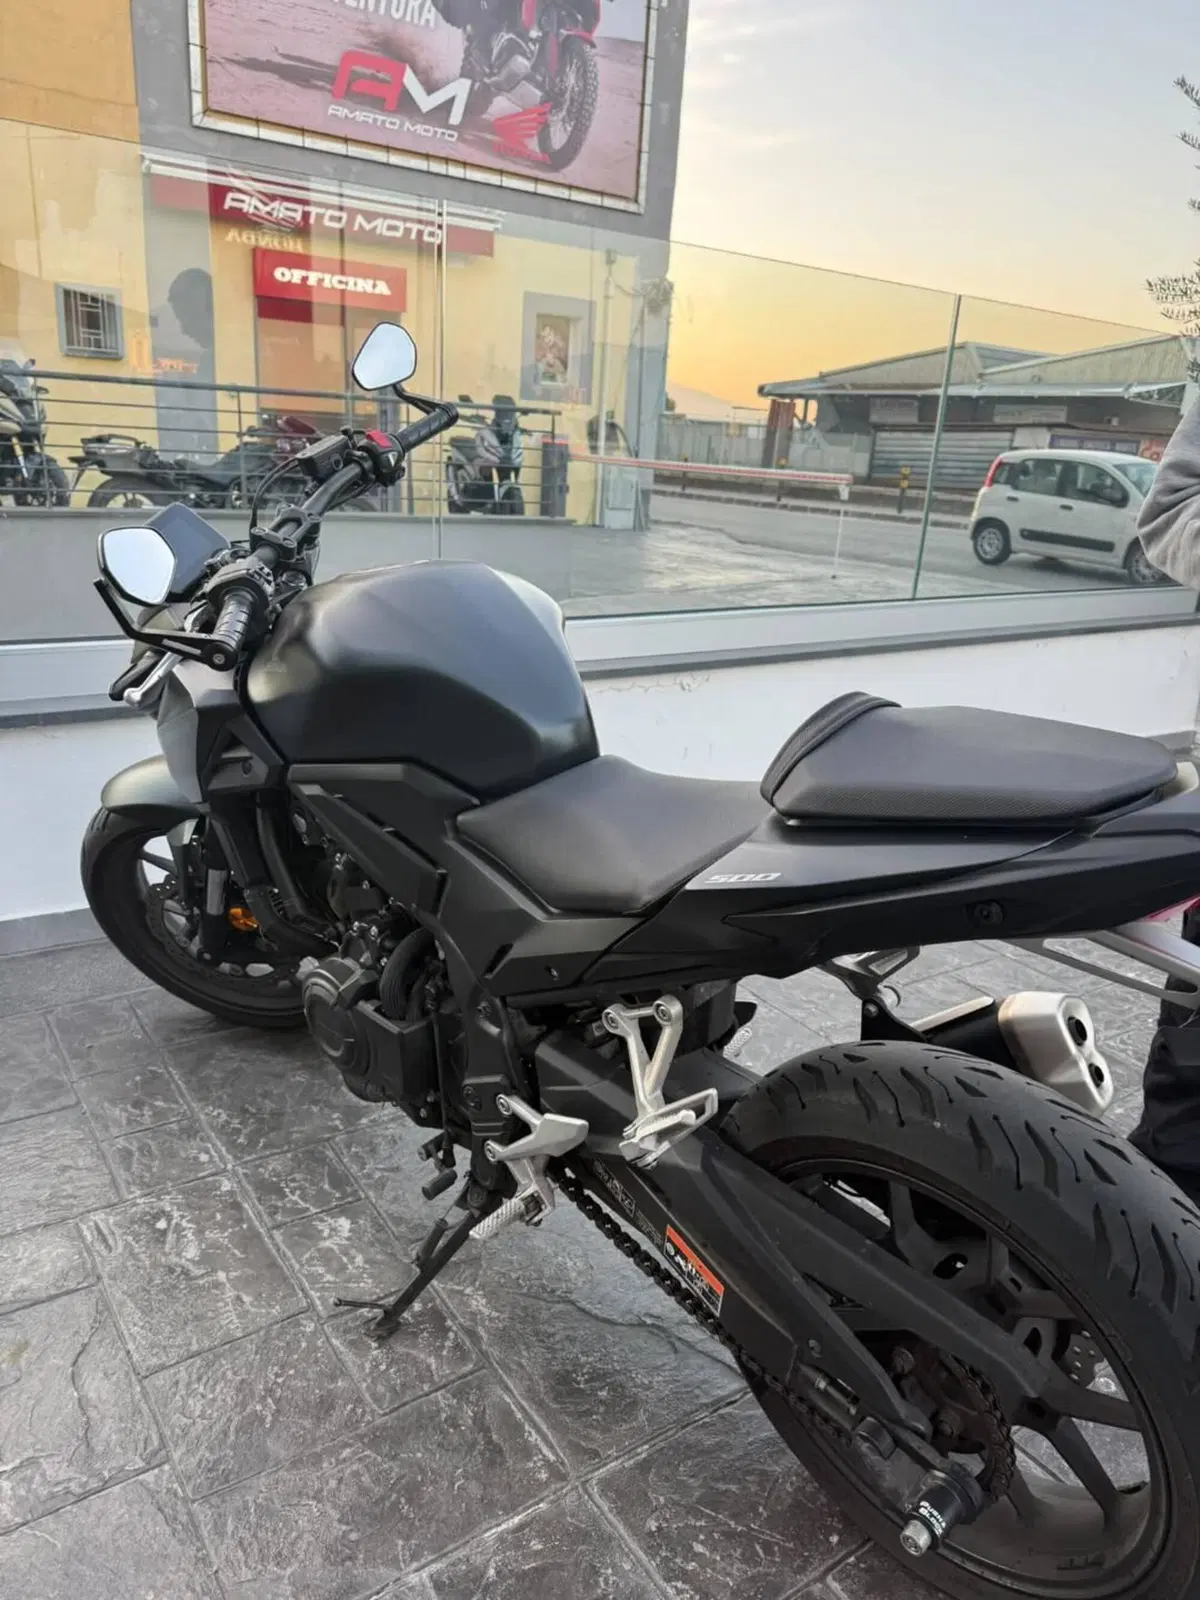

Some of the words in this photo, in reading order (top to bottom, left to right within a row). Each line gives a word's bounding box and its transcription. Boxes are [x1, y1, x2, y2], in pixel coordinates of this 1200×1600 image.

[331, 49, 473, 125] AM
[327, 104, 400, 131] AMATO
[404, 121, 460, 143] MOTO
[223, 191, 347, 229] AMATO
[353, 214, 442, 245] MOTO
[273, 267, 391, 295] OFFICINA
[704, 872, 782, 884] 500
[919, 1507, 943, 1534] BLOCK
